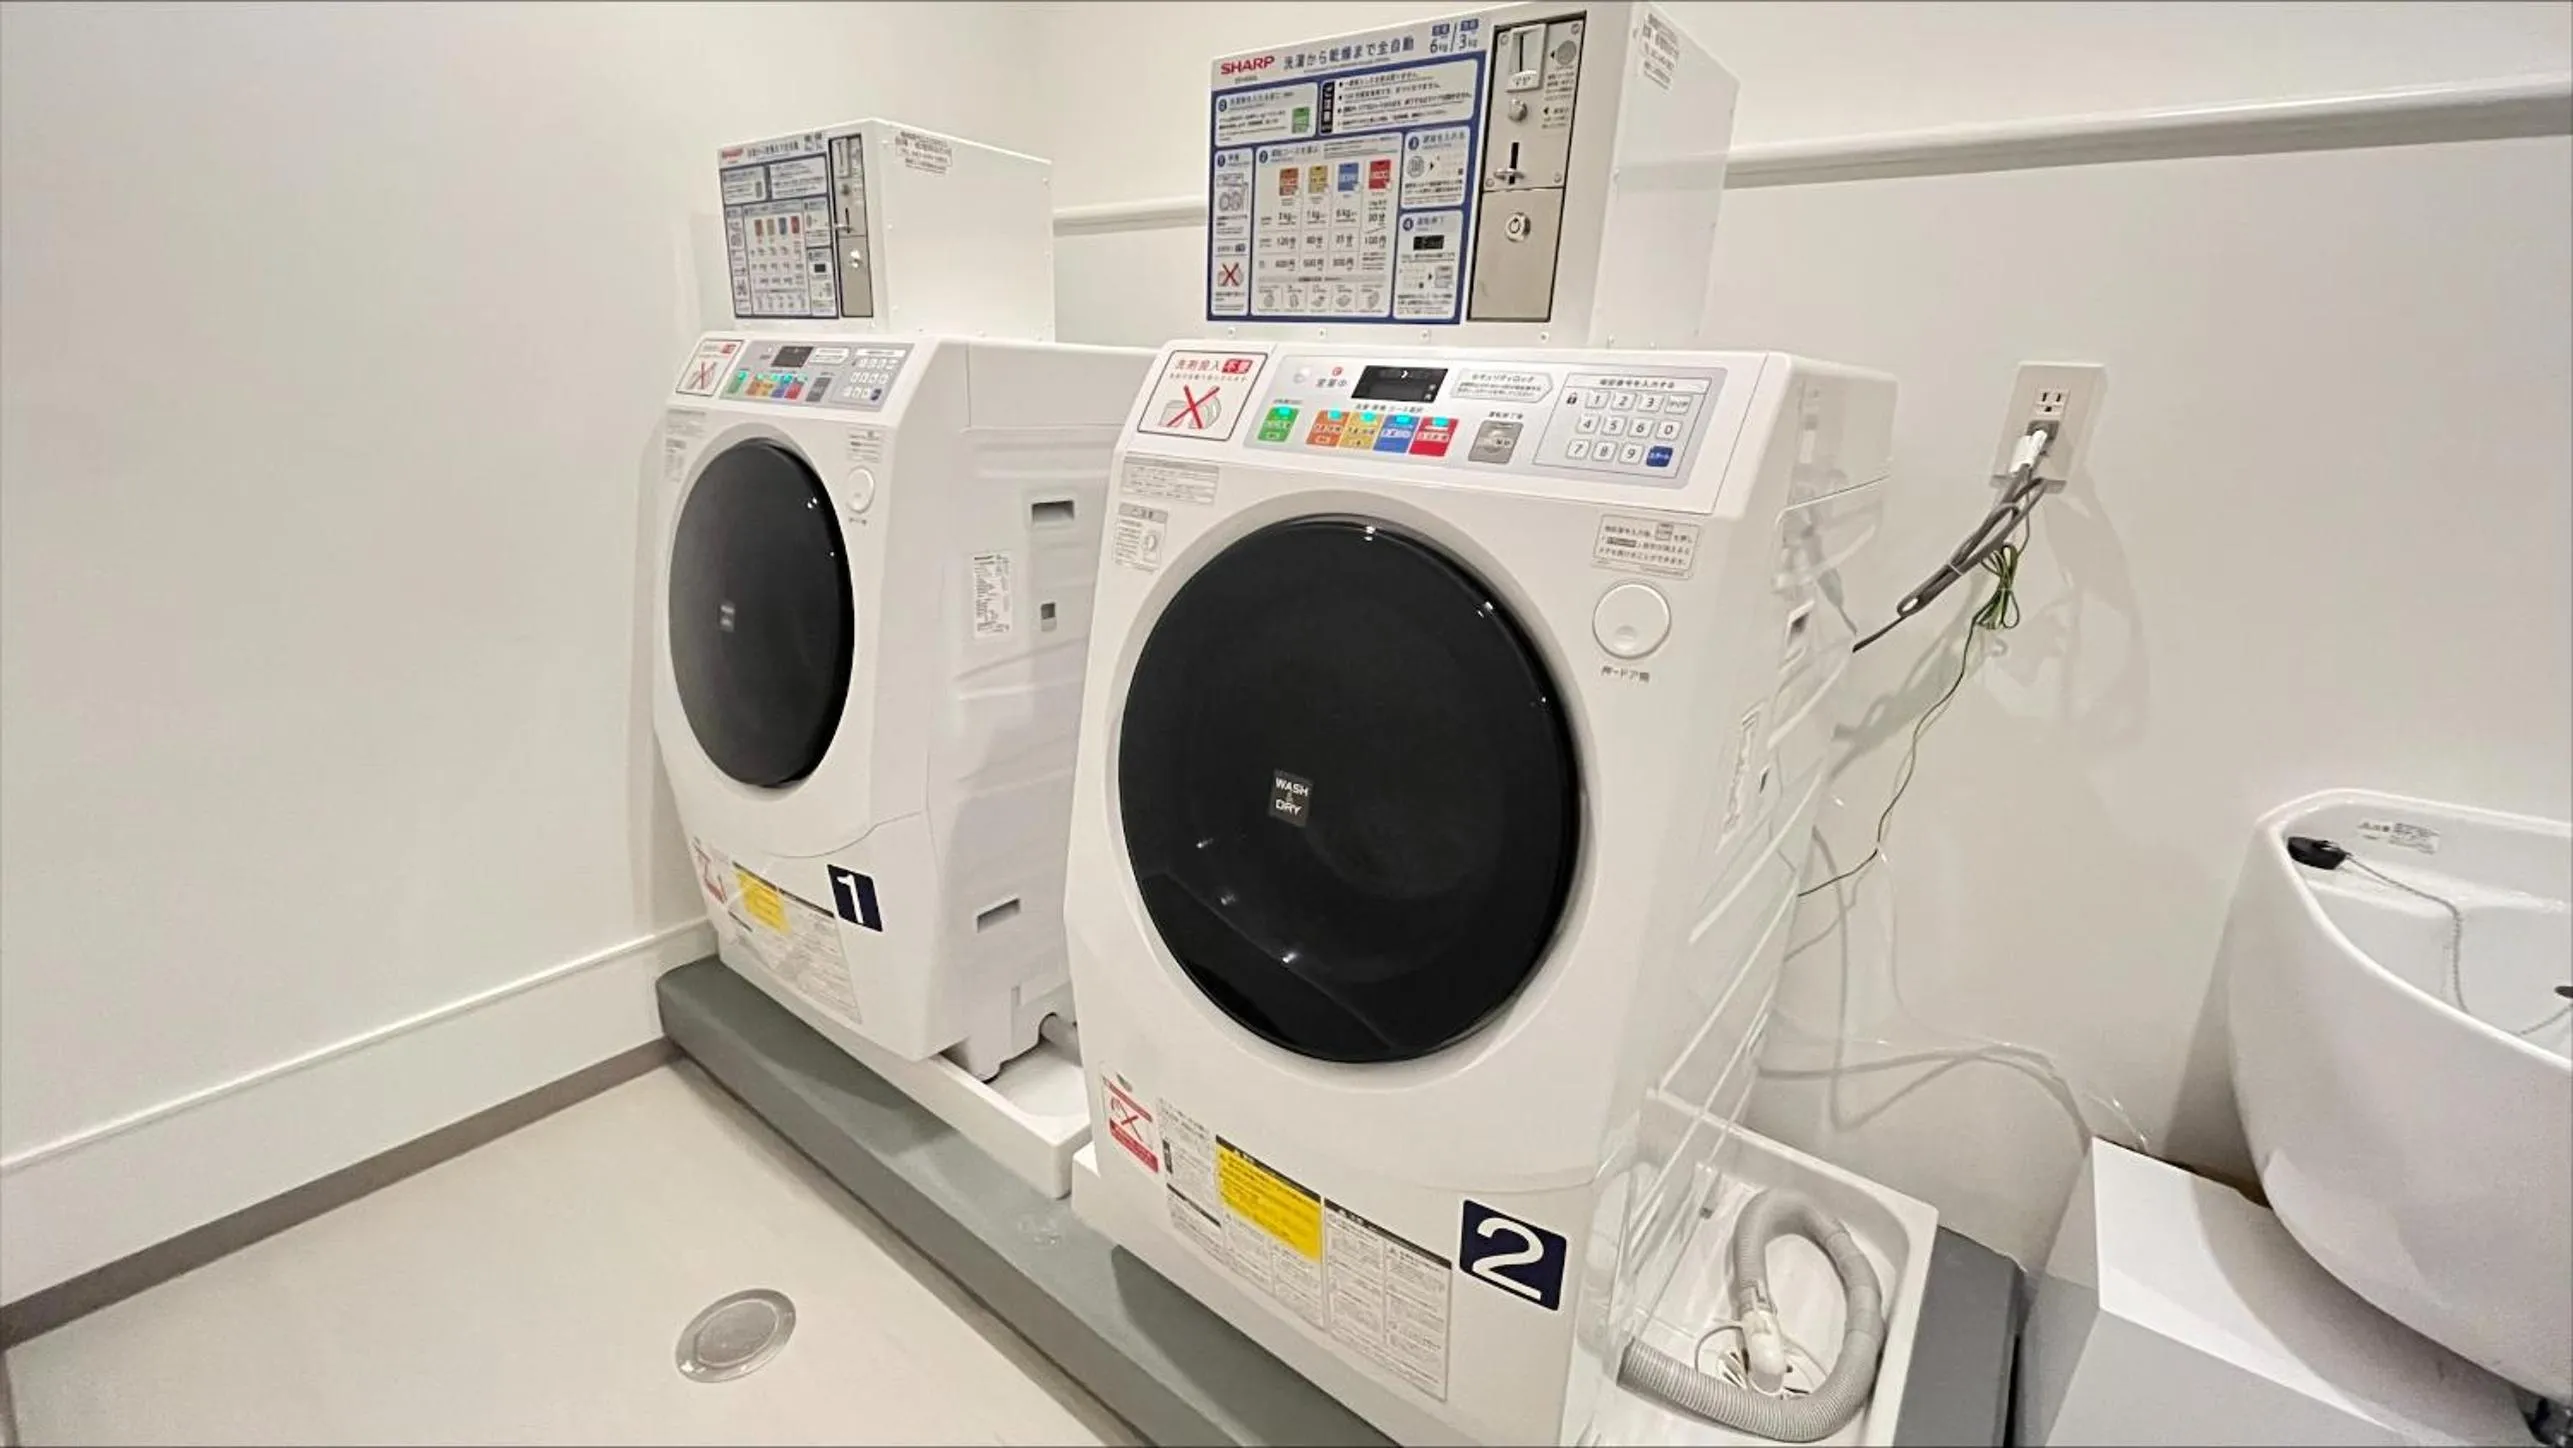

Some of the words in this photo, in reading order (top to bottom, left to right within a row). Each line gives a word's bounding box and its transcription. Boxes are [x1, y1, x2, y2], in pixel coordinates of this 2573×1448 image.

[1220, 56, 1275, 75] SHARP
[1594, 395, 1601, 405] 1
[1618, 395, 1629, 406] 2
[1647, 397, 1655, 407] 3
[1583, 418, 1591, 429] 4
[1610, 420, 1618, 431] 5
[1635, 422, 1645, 434] 6
[1664, 424, 1674, 436] 0
[1574, 443, 1583, 455] 7
[1600, 446, 1609, 458] 8
[1627, 448, 1636, 460] 9
[1275, 777, 1309, 797] WASH
[1275, 798, 1302, 816] DRY
[836, 874, 865, 924] 1
[1472, 1216, 1545, 1302] 2
